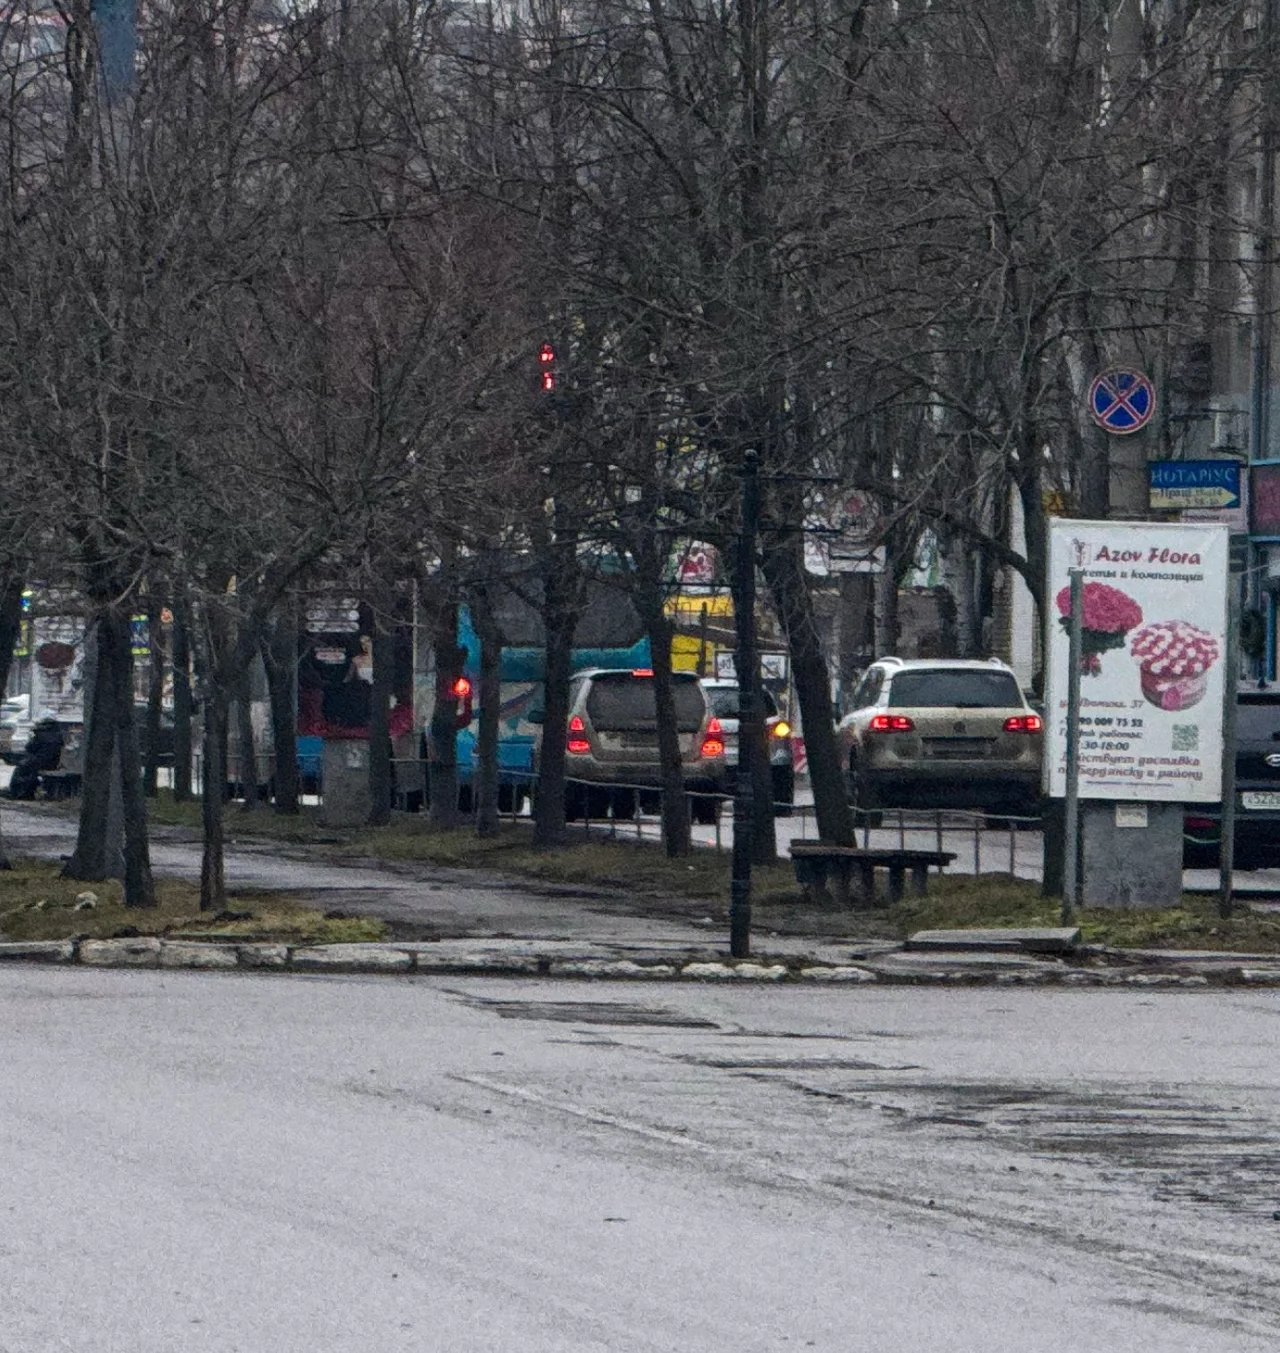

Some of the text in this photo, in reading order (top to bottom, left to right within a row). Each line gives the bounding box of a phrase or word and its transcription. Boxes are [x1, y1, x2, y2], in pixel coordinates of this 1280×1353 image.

[1095, 545, 1202, 565] Azov Flora
[1131, 569, 1204, 583] композиции
[1138, 755, 1201, 767] доставка
[1158, 768, 1204, 781] району
